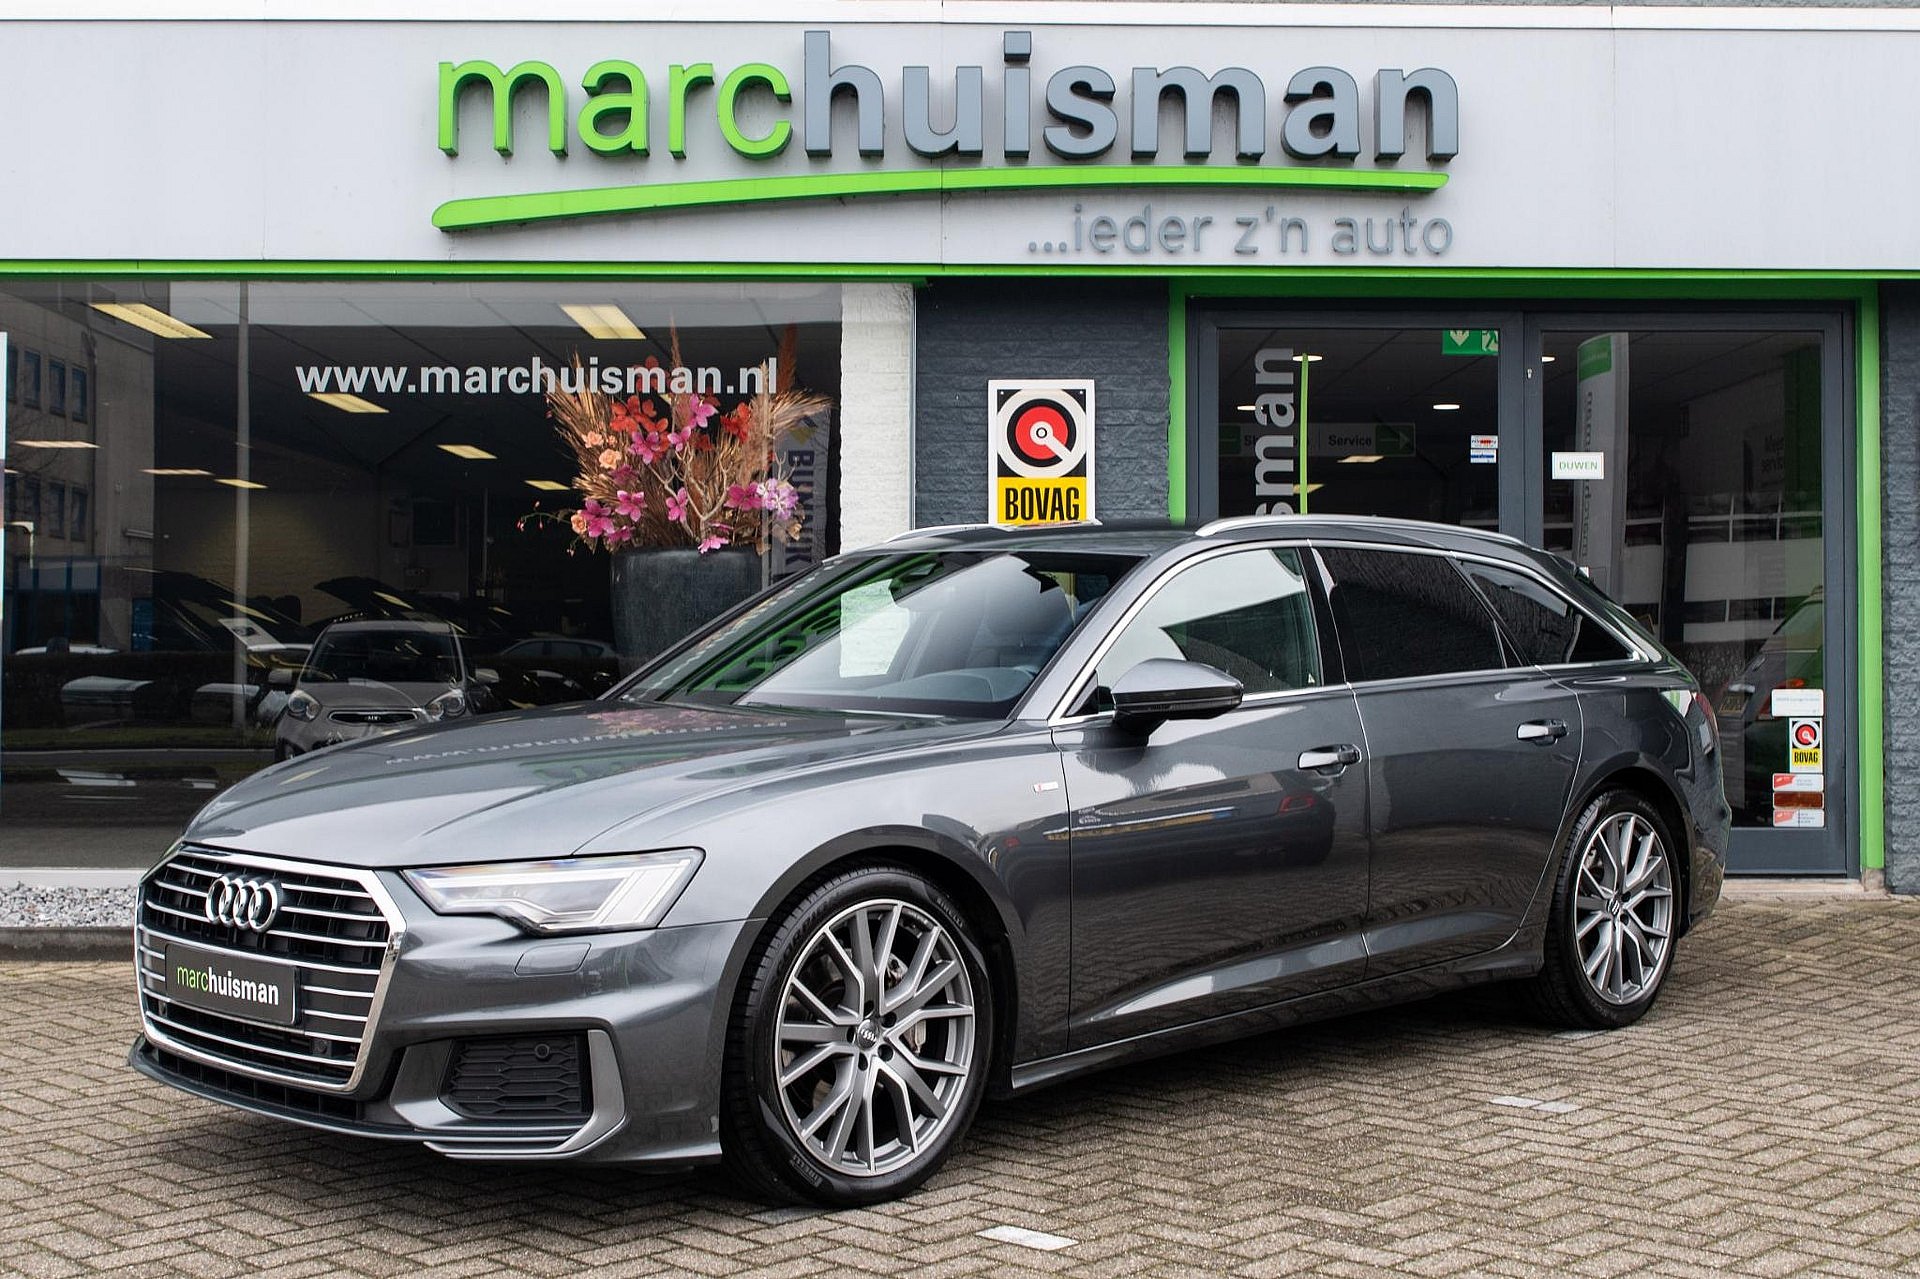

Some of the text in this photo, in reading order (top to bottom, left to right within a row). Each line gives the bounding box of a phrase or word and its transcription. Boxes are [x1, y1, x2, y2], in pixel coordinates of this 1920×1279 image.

[438, 30, 1458, 163] marchuisman
[1028, 203, 1454, 256] ...ieder z'n auto
[295, 356, 778, 395] www.marchuisman.nl
[1328, 434, 1372, 448] Service
[1559, 461, 1598, 471] DUWEN
[1005, 486, 1080, 522] BOVAG
[1793, 751, 1819, 764] BOVAG
[176, 965, 280, 1006] marchuisman
